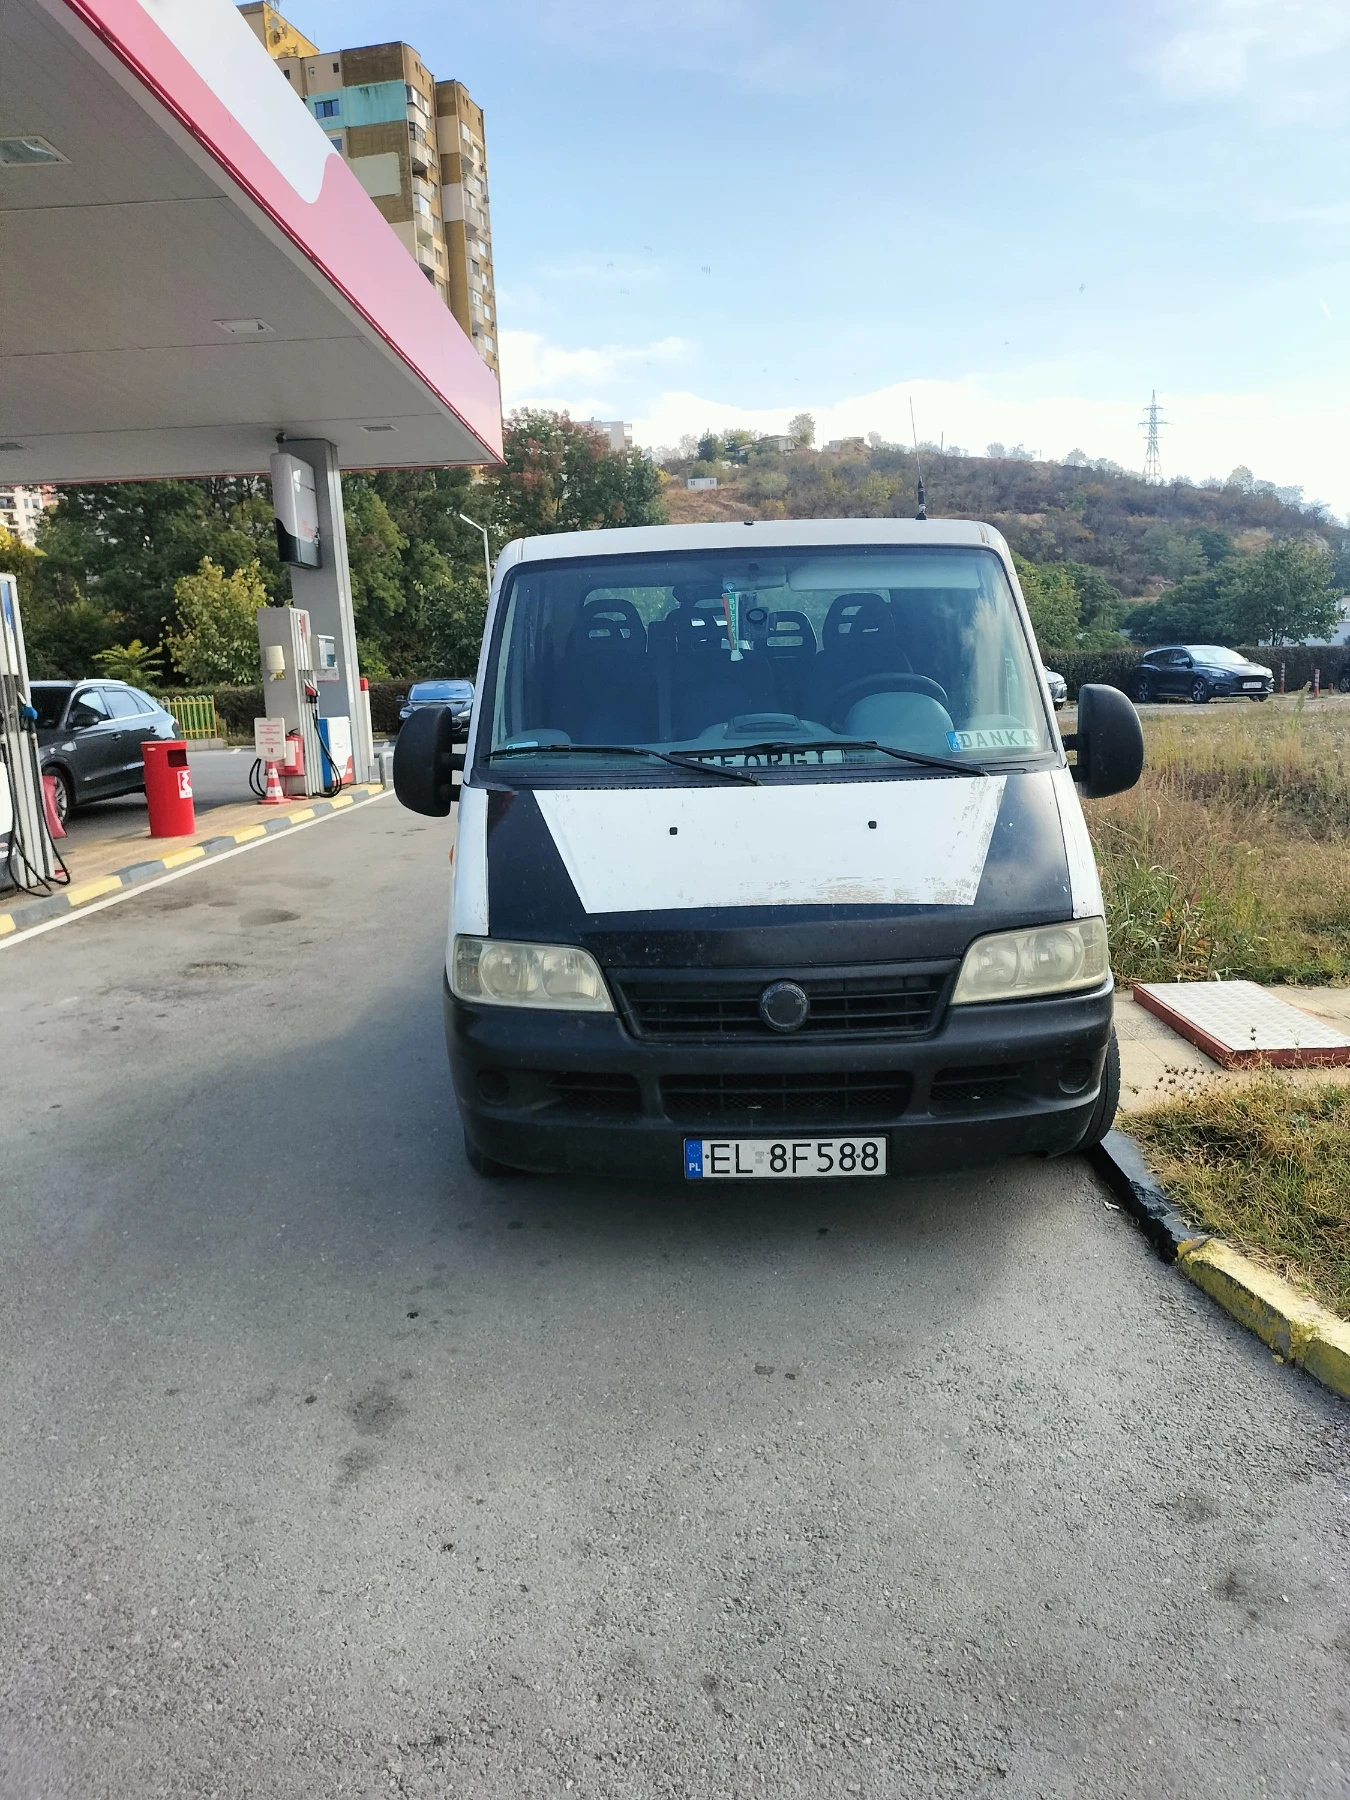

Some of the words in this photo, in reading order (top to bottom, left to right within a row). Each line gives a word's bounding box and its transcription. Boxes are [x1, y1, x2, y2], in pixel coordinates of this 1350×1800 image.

[959, 730, 1035, 748] DANKA
[689, 1162, 701, 1172] PL
[710, 1143, 753, 1174] EL
[769, 1142, 879, 1174] 8F588
